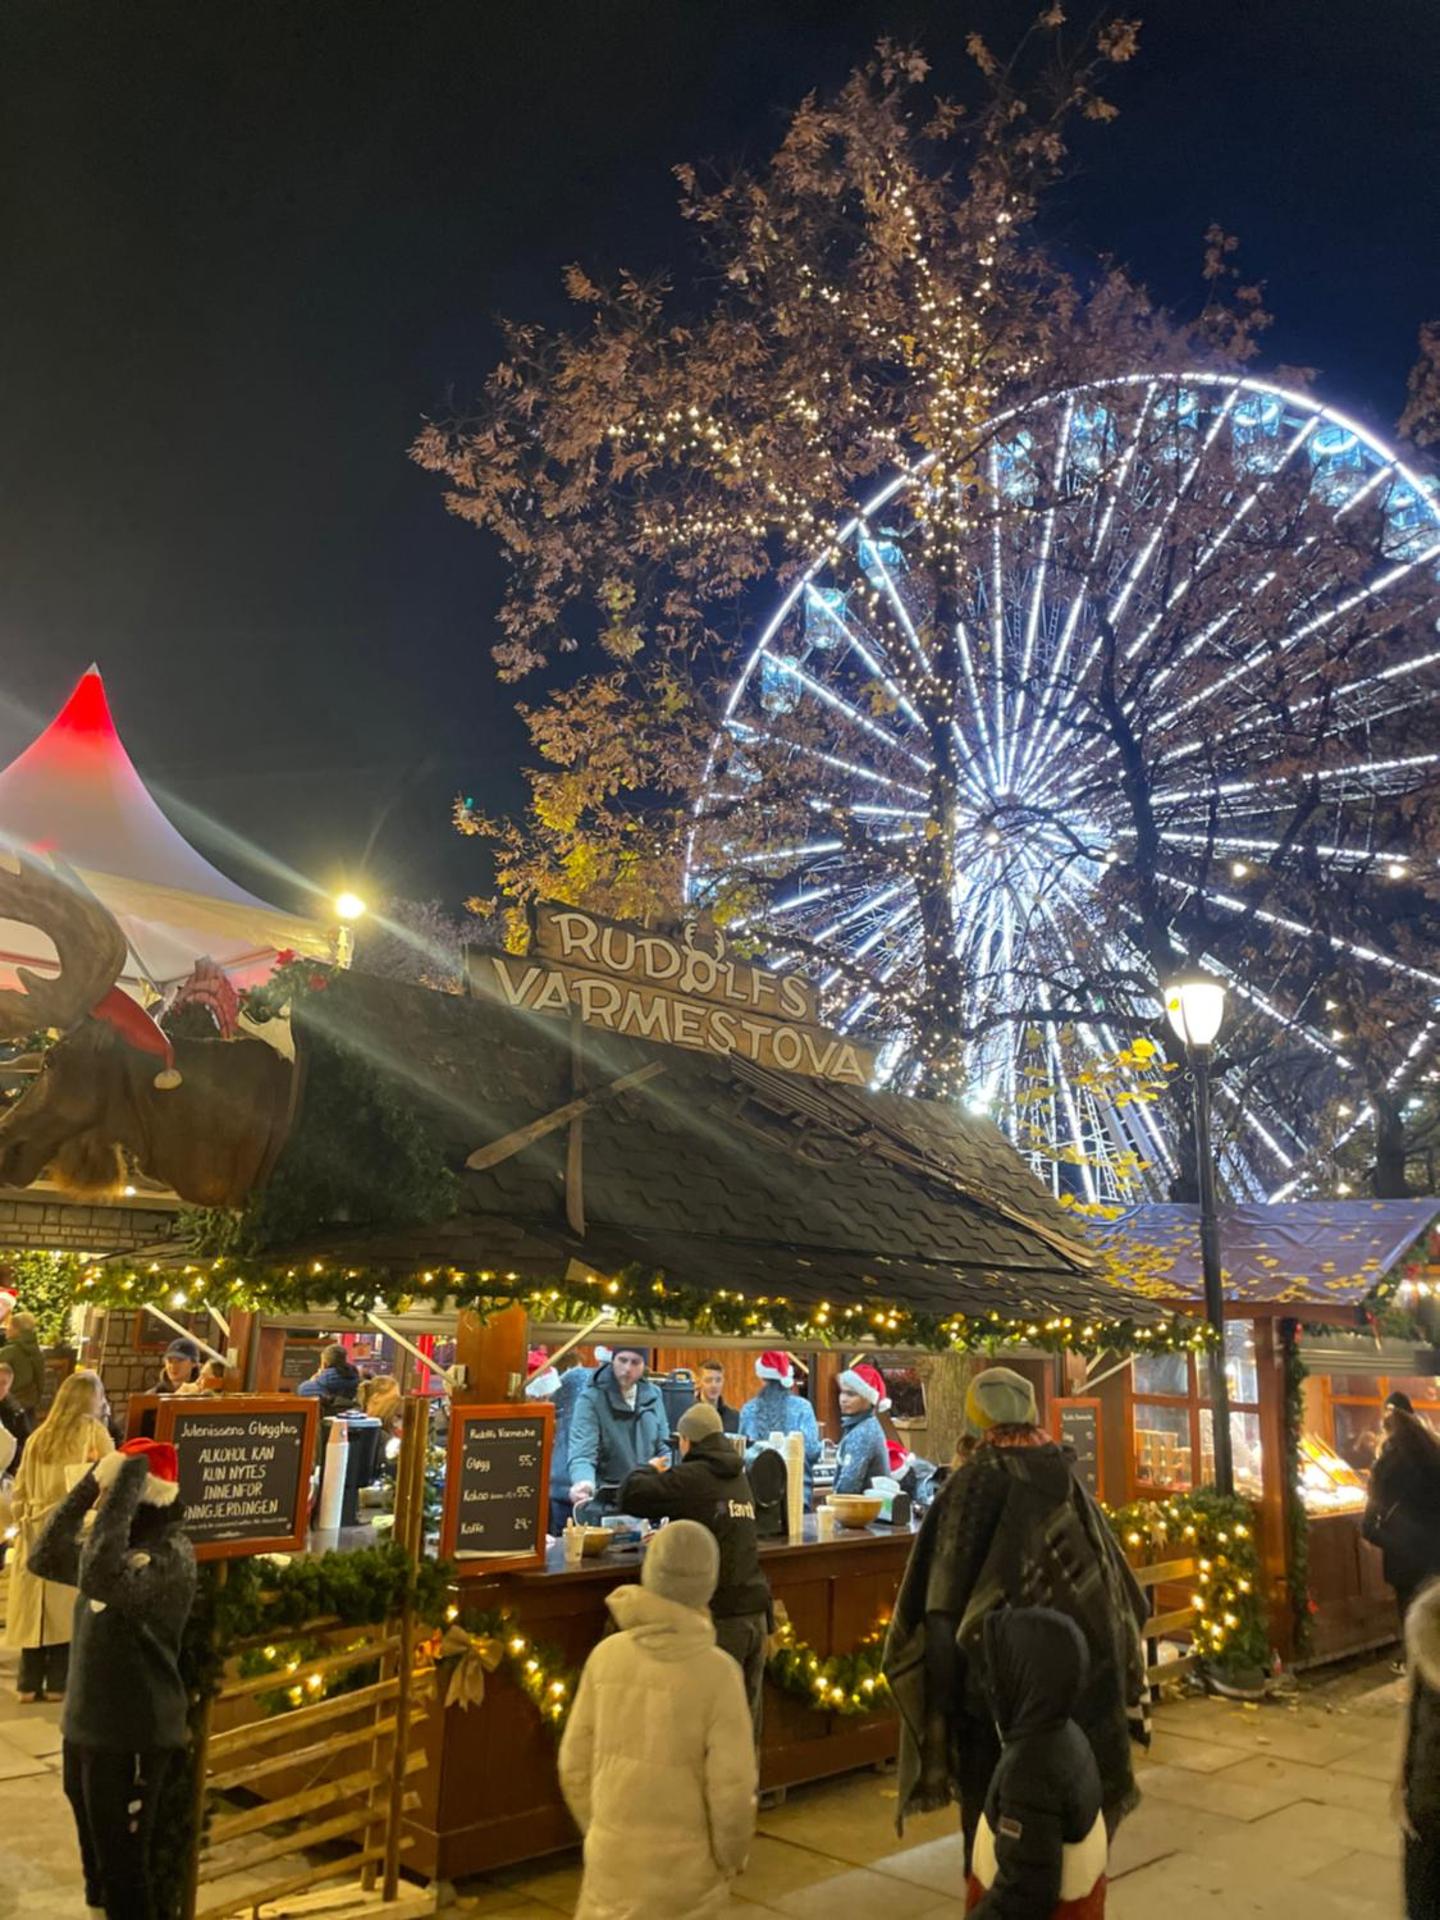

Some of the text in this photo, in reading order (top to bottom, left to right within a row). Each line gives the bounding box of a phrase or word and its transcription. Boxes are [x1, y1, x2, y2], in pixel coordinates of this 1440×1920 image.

[551, 912, 808, 1019] RUDOLFS
[491, 957, 868, 1083] VARMESTOVA
[181, 1422, 245, 1438] Julenissens
[199, 1445, 275, 1463] ALKOHOL KAN
[203, 1464, 267, 1481] KUN NYTES
[204, 1482, 263, 1500] INNENFOR
